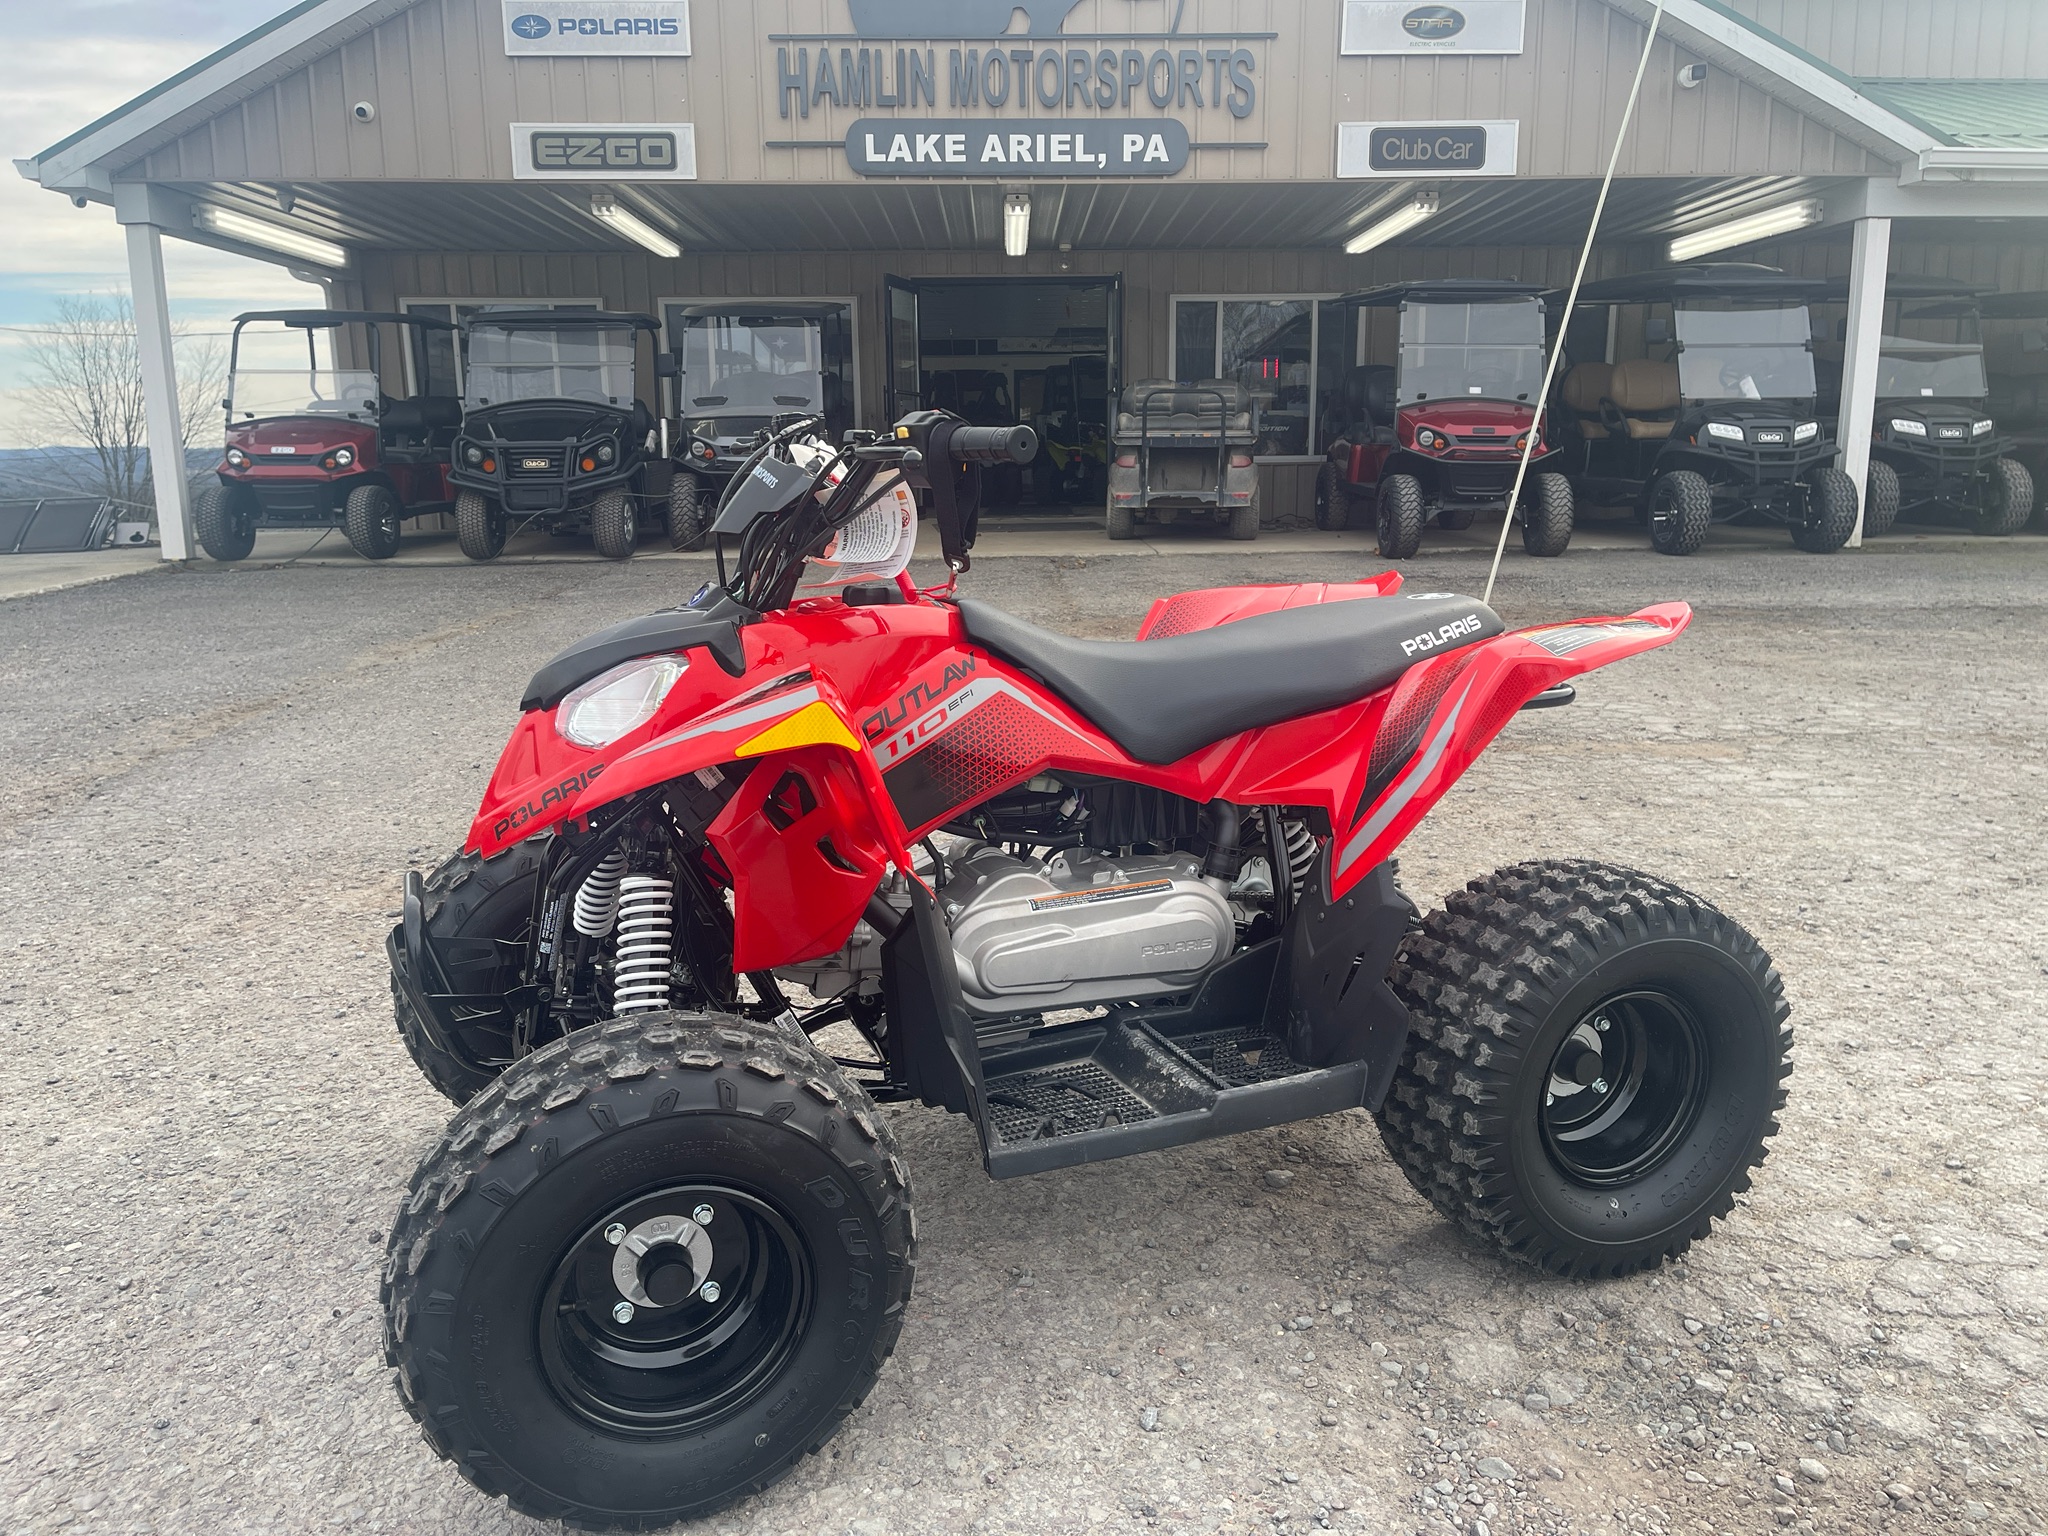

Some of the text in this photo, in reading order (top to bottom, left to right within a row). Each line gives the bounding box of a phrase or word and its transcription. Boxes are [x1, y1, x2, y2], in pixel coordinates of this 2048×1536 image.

[558, 18, 679, 35] POLARIS
[1405, 18, 1454, 28] STAR
[777, 47, 1256, 119] HAMLIN MOTORSPORTS
[536, 137, 672, 165] EZGO
[865, 133, 1170, 169] LAKE ARIEL, PA
[1382, 136, 1473, 160] Club Car
[841, 524, 849, 551] WARNIN
[1401, 614, 1482, 657] POLARIS
[862, 650, 976, 741] OUTLAW
[885, 689, 974, 758] 110 EFI
[1141, 937, 1213, 958] POLARIS
[1661, 1092, 1745, 1208] DURO
[803, 1174, 873, 1363] DURO
